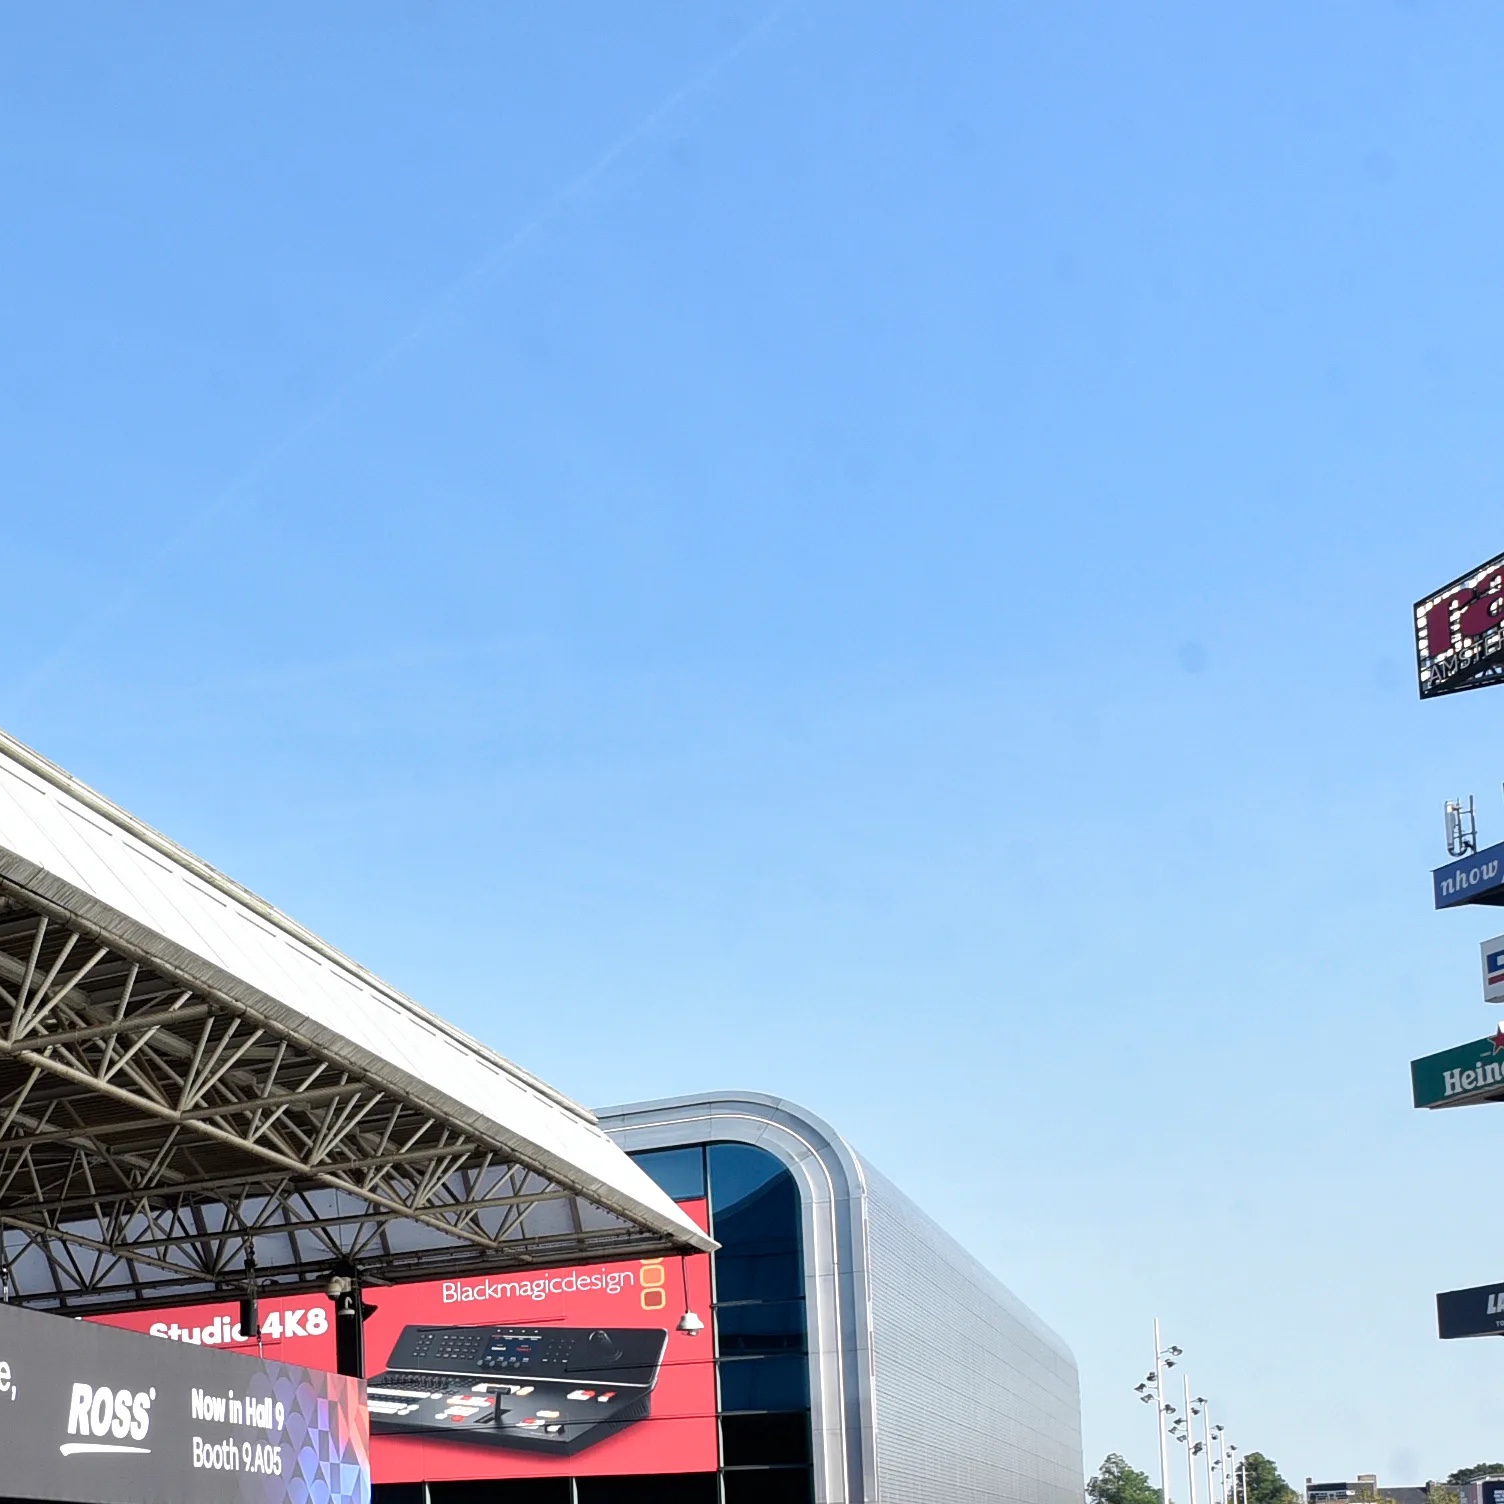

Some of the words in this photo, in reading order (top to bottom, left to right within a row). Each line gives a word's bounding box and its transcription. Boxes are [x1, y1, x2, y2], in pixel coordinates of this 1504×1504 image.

[1440, 858, 1499, 897] nhow
[442, 1268, 635, 1304] Blackmagicdesign
[261, 1308, 329, 1339] 4K8
[192, 1387, 225, 1422] Now
[228, 1390, 243, 1424] in
[245, 1394, 273, 1427] Hall
[275, 1401, 285, 1429] 9
[192, 1437, 239, 1471] Booth
[242, 1443, 283, 1475] 9.A05
